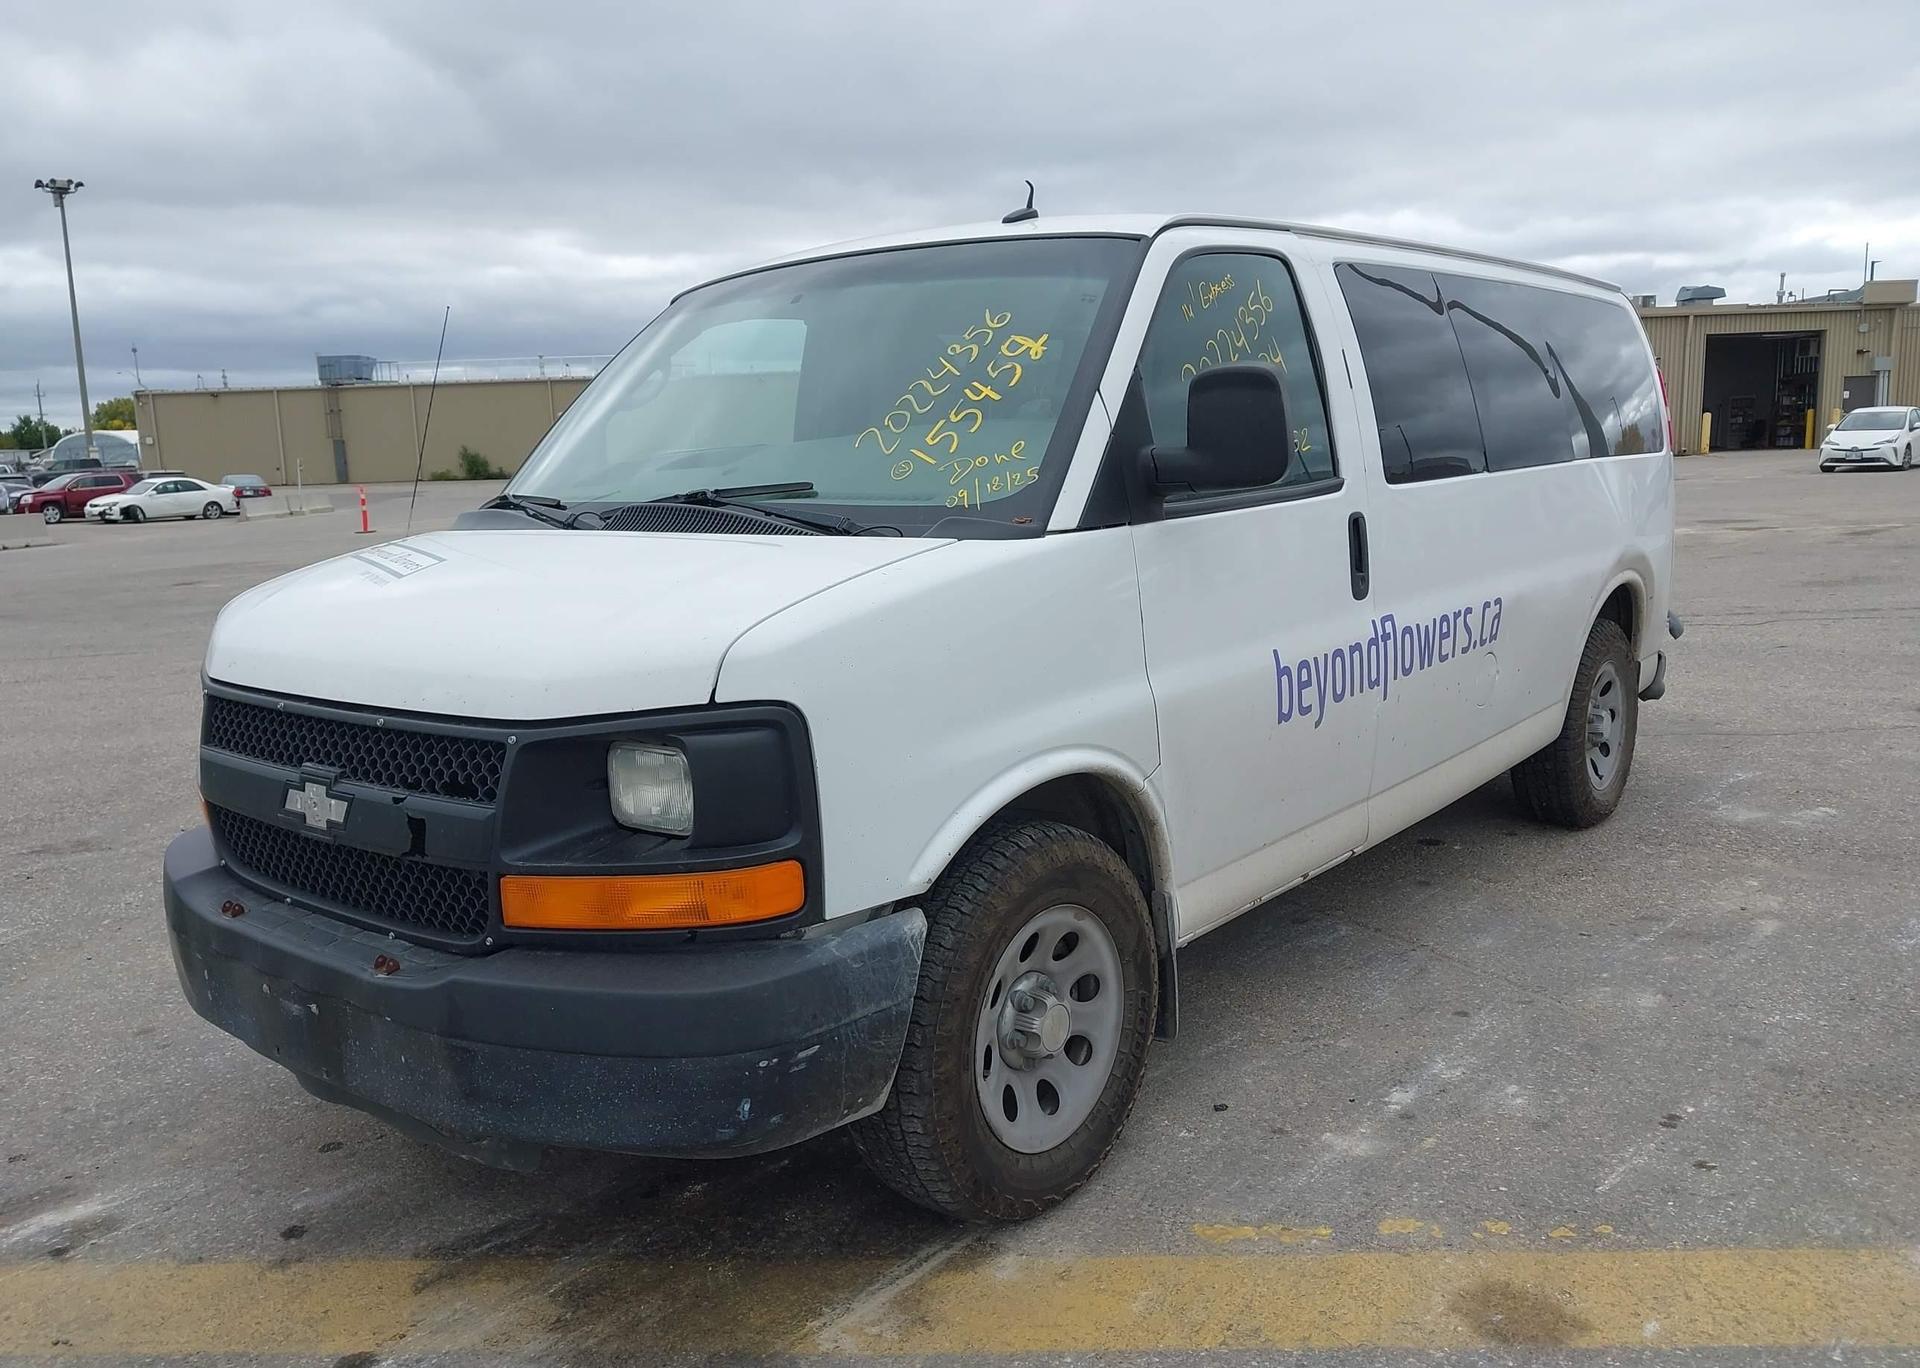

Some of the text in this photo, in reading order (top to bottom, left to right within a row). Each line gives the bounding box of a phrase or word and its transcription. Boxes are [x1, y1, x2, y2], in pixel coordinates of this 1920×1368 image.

[855, 308, 1012, 455] 20224356
[937, 440, 1027, 486] Done
[944, 466, 1041, 512] 09/18/25
[1272, 597, 1504, 730] beyondflowers.ca
